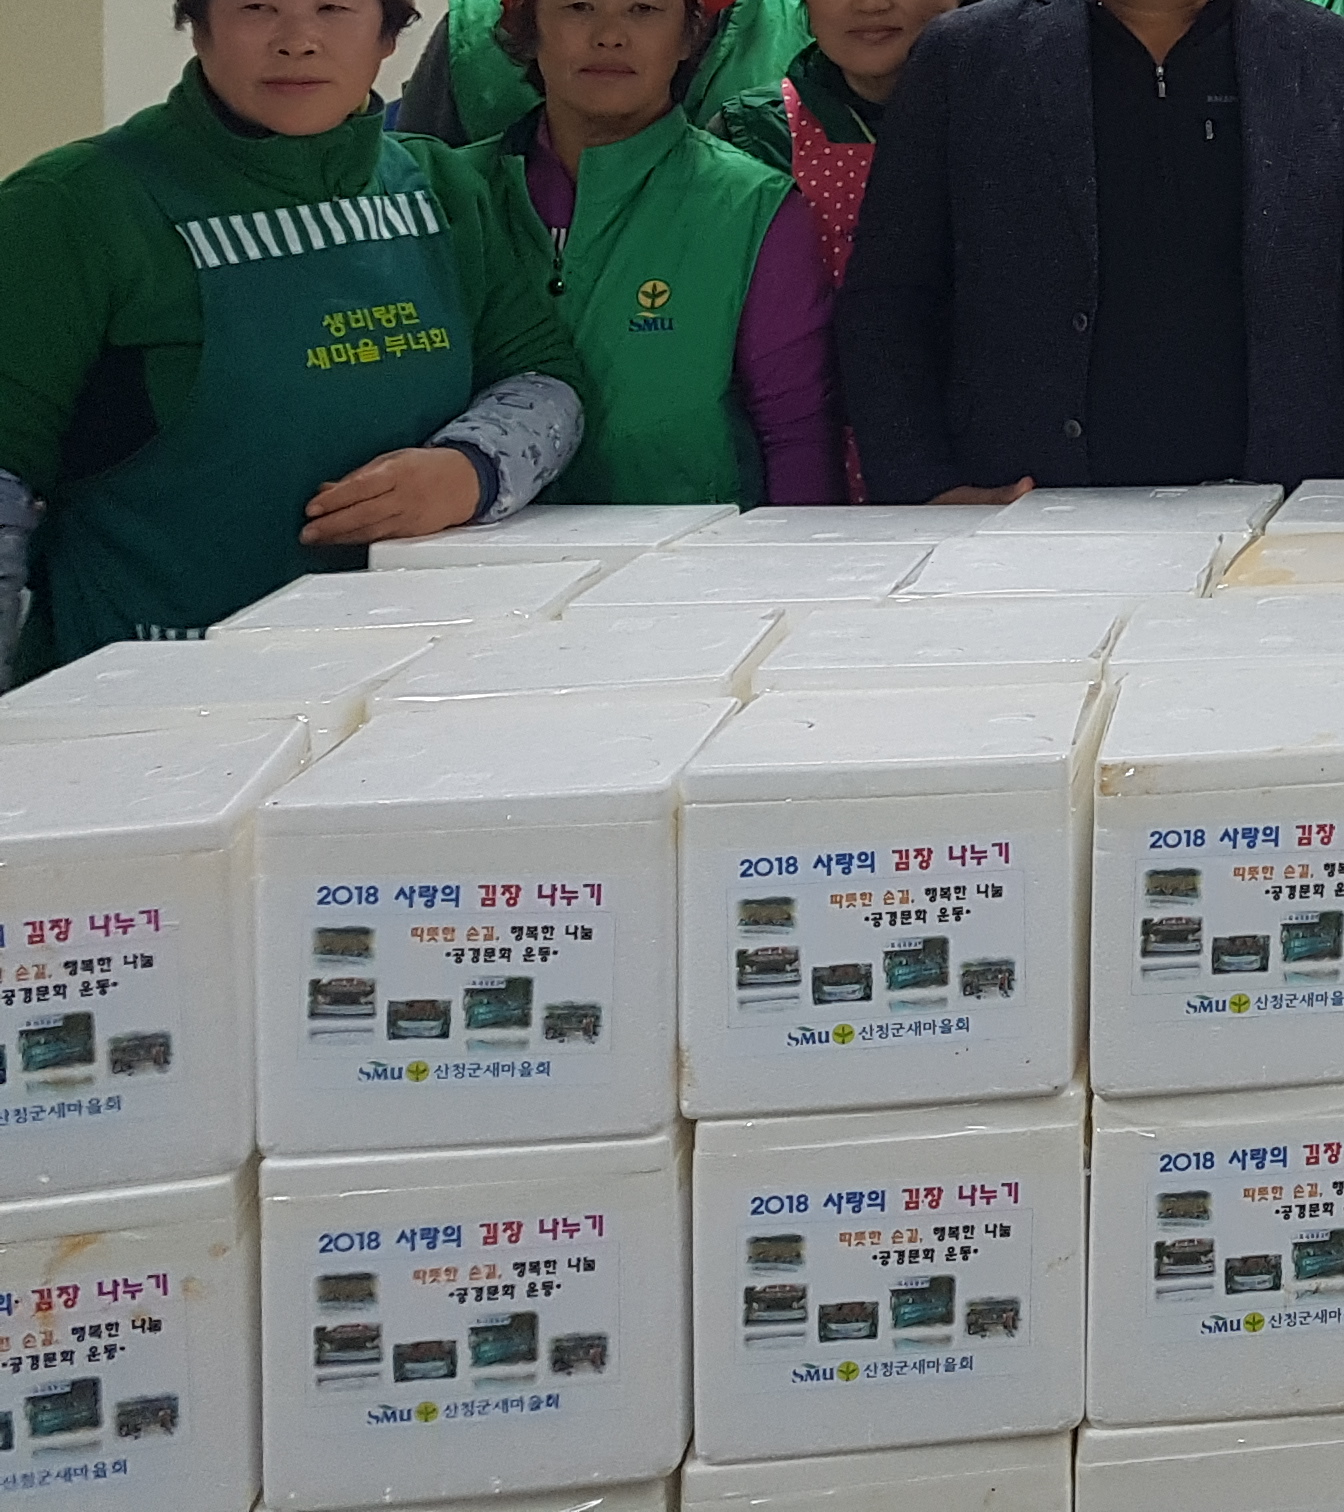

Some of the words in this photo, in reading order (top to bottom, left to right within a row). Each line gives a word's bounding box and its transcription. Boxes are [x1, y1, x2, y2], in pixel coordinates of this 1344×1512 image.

[322, 302, 421, 338] 생비량면
[628, 317, 674, 333] SMU
[306, 338, 380, 370] 새마을
[384, 327, 450, 358] 부녀회
[1148, 829, 1206, 850] 2018
[1218, 826, 1280, 850] 사랑의
[1293, 823, 1335, 847] 김장
[738, 856, 799, 879] 2018
[812, 851, 876, 878] 사랑의
[891, 847, 934, 872] 김장
[948, 842, 1010, 869] 나누기
[315, 886, 380, 906] 2018
[393, 885, 461, 909] 사랑의
[477, 884, 522, 908] 김장
[536, 884, 603, 907] 나누기
[830, 891, 872, 910] 따뜻한
[924, 885, 967, 903] 행복한
[976, 882, 1003, 900] 나눔
[787, 1026, 830, 1048] SMU
[858, 1016, 970, 1042] 산청군새마을회
[1158, 1151, 1215, 1173] 2018
[1227, 1146, 1288, 1172] 사랑의
[1302, 1142, 1342, 1167] 김장
[749, 1194, 810, 1216] 2018
[822, 1190, 886, 1216] 사랑의
[901, 1186, 944, 1211] 김장
[957, 1182, 1020, 1208] 나누기
[317, 1231, 381, 1254] 2018
[395, 1225, 462, 1253] 사랑의
[478, 1220, 523, 1247] 김장
[538, 1215, 604, 1242] 나누기
